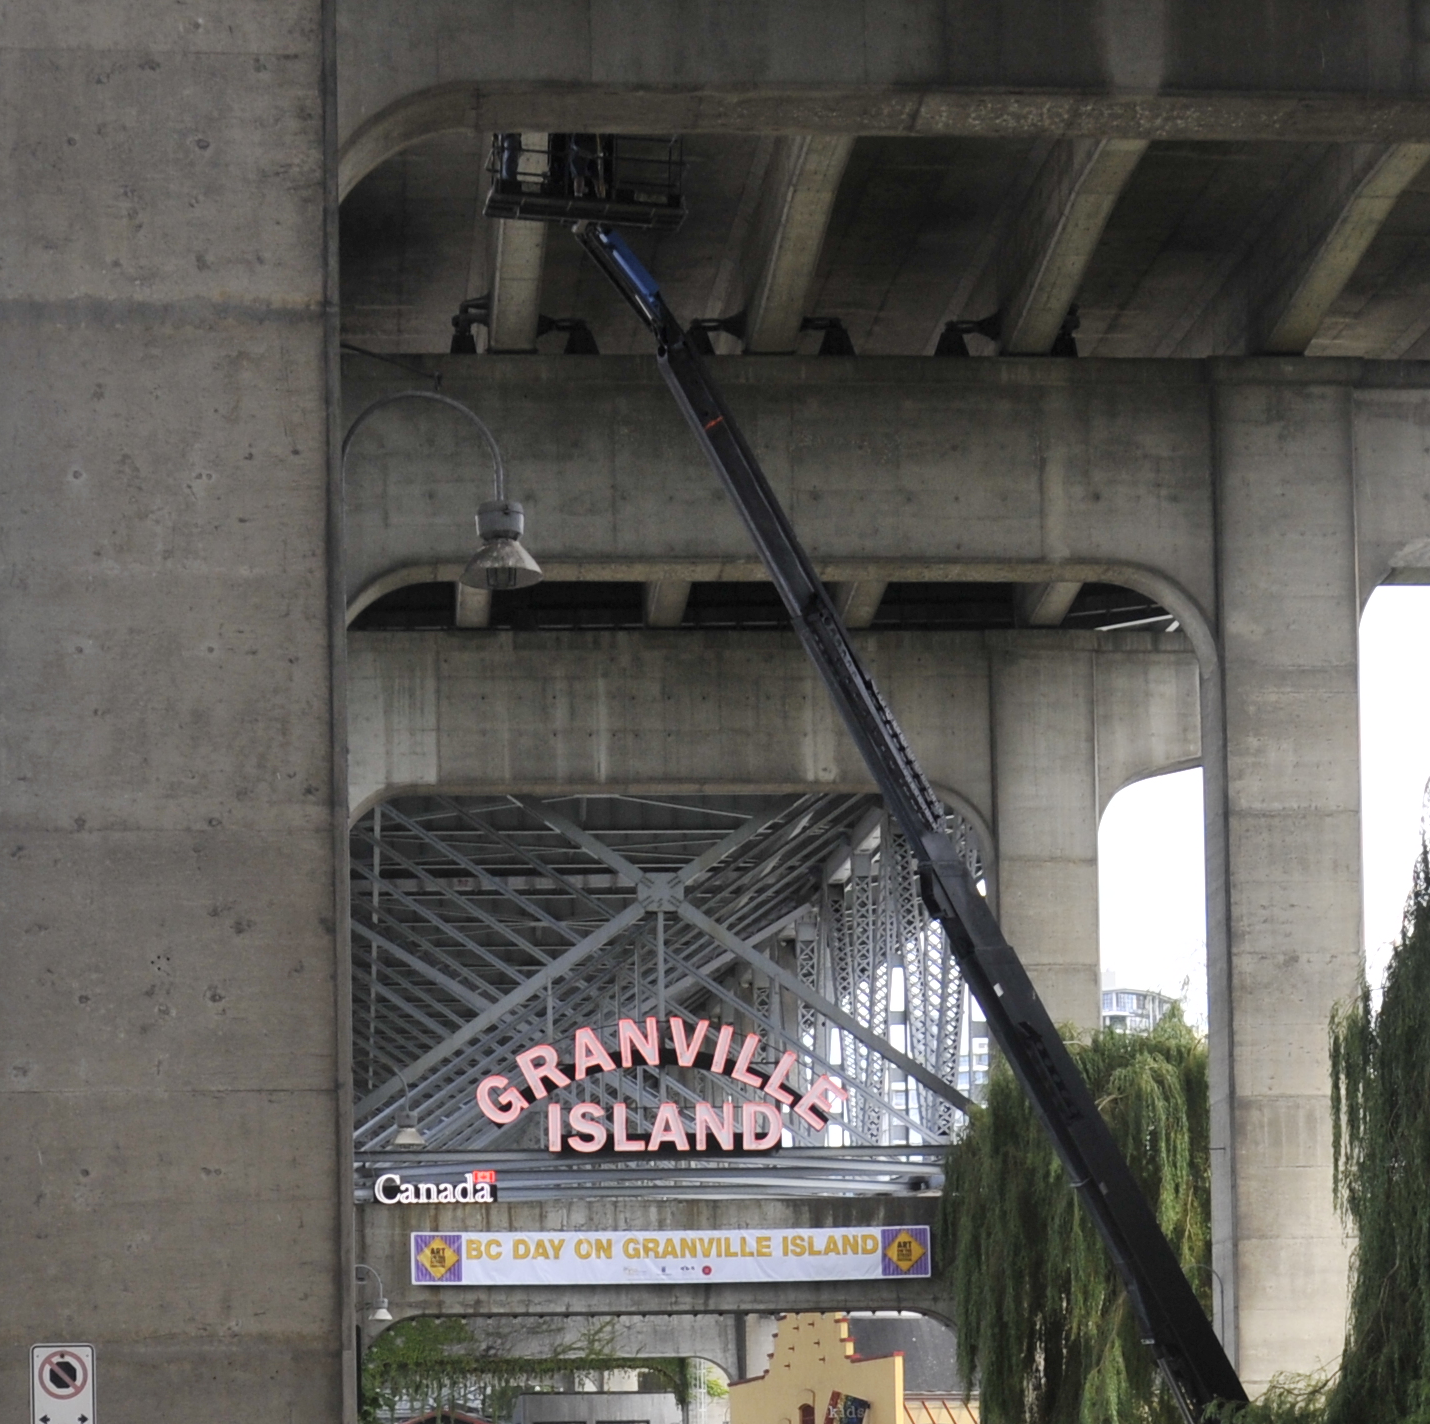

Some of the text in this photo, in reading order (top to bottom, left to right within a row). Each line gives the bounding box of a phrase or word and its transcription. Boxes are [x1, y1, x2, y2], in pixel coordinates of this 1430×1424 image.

[476, 1016, 848, 1131] GRANVILLE
[548, 1102, 782, 1152] ISLAND
[374, 1172, 493, 1204] Canada
[466, 1239, 503, 1260] BC
[513, 1239, 565, 1260] DAY
[575, 1238, 613, 1260] ON
[622, 1236, 772, 1259] GRANVILLE
[782, 1234, 879, 1256] ISLAND
[829, 1406, 865, 1418] kids
